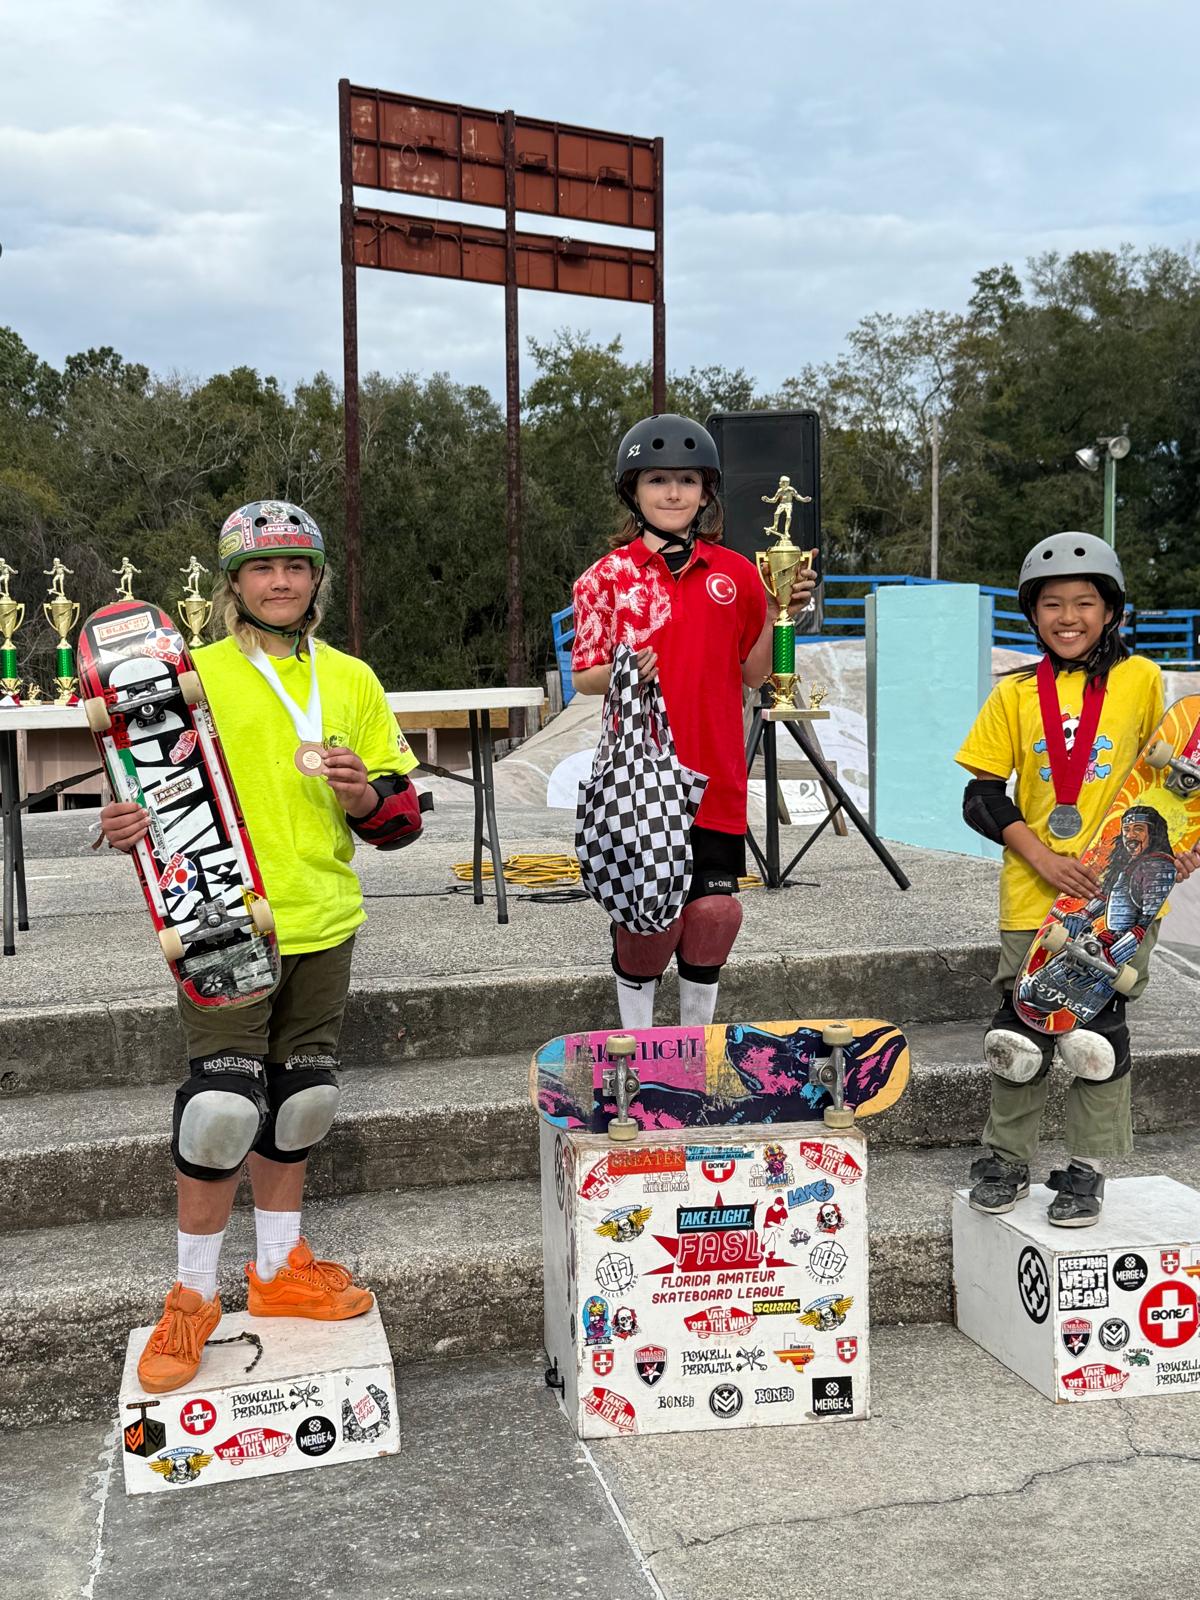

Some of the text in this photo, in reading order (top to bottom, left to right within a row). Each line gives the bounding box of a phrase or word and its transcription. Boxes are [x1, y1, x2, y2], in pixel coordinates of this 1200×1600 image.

[159, 853, 184, 891] TRACKER
[203, 1056, 254, 1073] BONELESS
[610, 1152, 684, 1168] GREATER
[822, 1143, 846, 1162] VANS
[590, 1161, 609, 1179] VAN
[707, 1161, 730, 1169] BONES
[820, 1155, 838, 1173] THE
[642, 1182, 690, 1193] KILLER PADS
[680, 1208, 750, 1227] TAKE FLIGHT
[676, 1230, 765, 1266] FASL
[812, 1247, 849, 1273] 187
[1058, 1256, 1108, 1271] KEEPING
[597, 1256, 632, 1287] 187
[661, 1271, 776, 1289] FLORIDA AMATEUR
[1060, 1268, 1108, 1290] VERT
[1115, 1269, 1146, 1282] MERGE4
[651, 1286, 786, 1304] SKATEBOARD LEAGUE
[1059, 1288, 1109, 1310] DEAD
[705, 1308, 732, 1320] VANS
[1151, 1307, 1190, 1321] BONES
[710, 1317, 730, 1332] THE
[681, 1348, 732, 1365] POWELL
[681, 1361, 736, 1376] PERALTA
[1080, 1365, 1107, 1376] VANS
[1084, 1377, 1103, 1389] THE
[230, 1388, 285, 1407] POWELL
[603, 1389, 627, 1411] VANS
[755, 1386, 795, 1404] BONES
[815, 1397, 852, 1411] MERGE4
[186, 1412, 210, 1422] BONES
[232, 1400, 290, 1421] PERALTA
[601, 1401, 617, 1422] THE
[236, 1428, 266, 1446] VANS
[299, 1433, 335, 1448] MERGE4
[242, 1442, 263, 1457] THE
